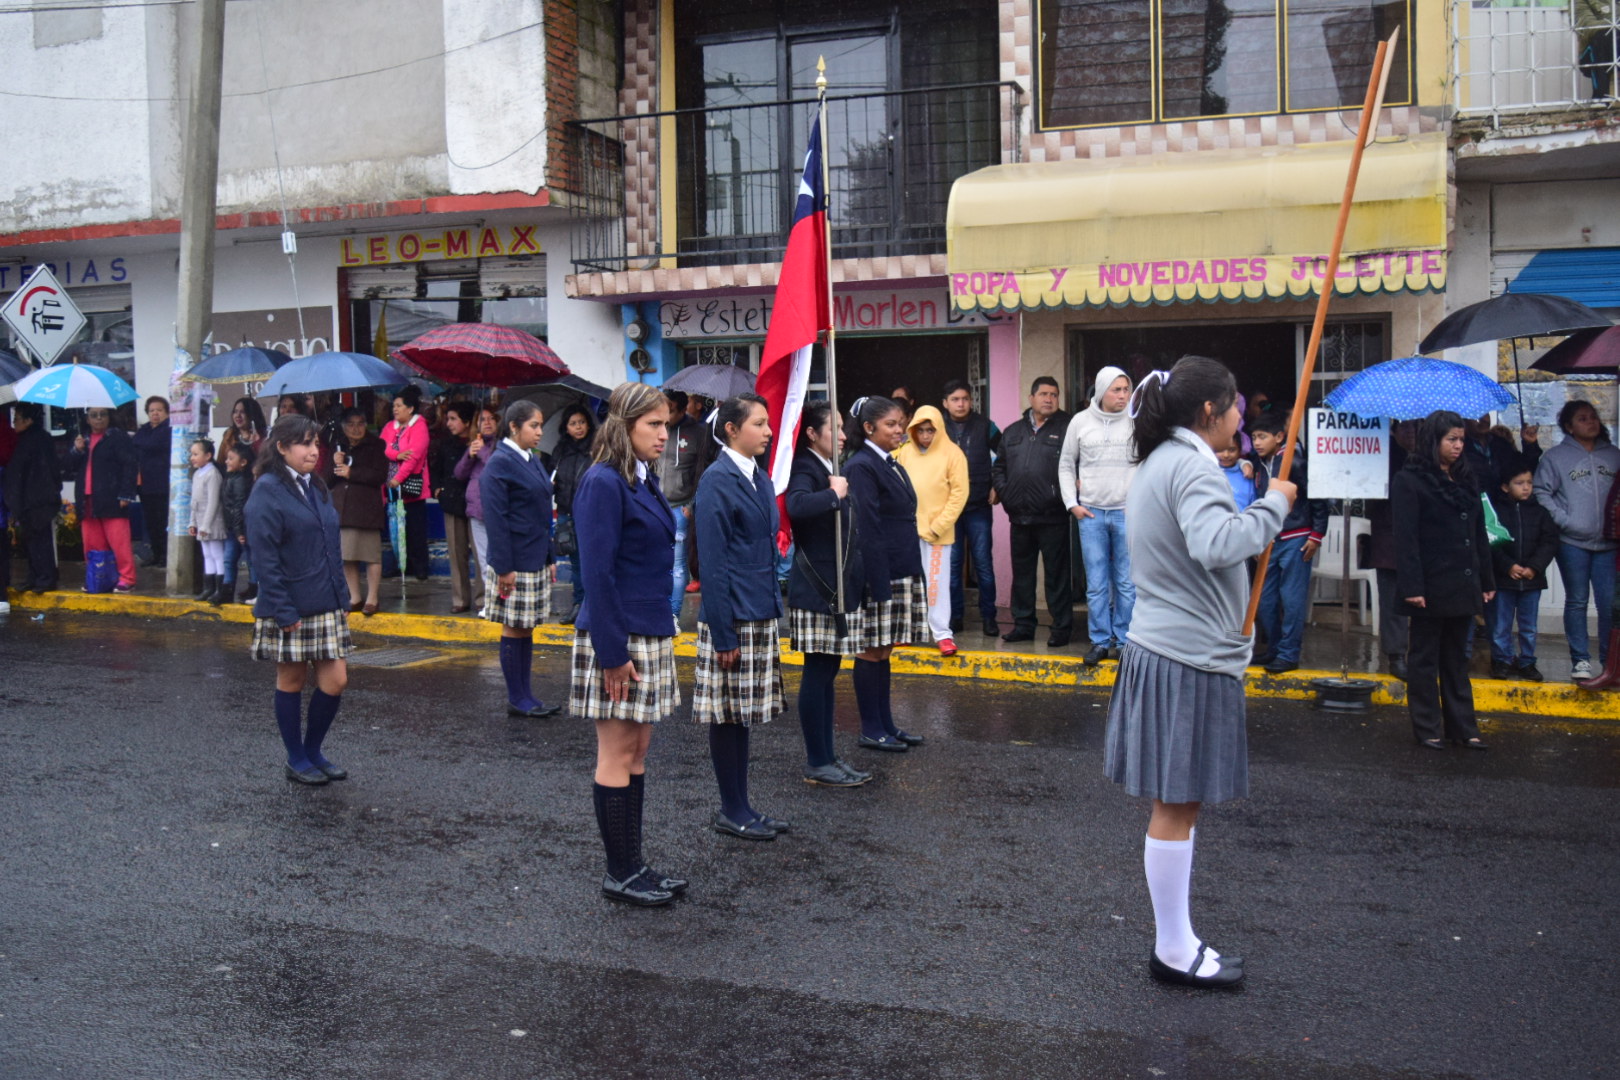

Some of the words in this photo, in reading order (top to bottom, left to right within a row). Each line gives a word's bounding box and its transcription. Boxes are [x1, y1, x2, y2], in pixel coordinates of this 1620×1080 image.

[342, 225, 538, 265] LEO-MAX
[952, 271, 1021, 297] ROPA
[1050, 268, 1068, 292] Y
[1098, 258, 1268, 288] NOVEDADES
[697, 299, 773, 334] Estet
[832, 294, 937, 329] Marlen
[1316, 412, 1382, 430] PARADA
[1316, 436, 1382, 455] EXCLUSIVA
